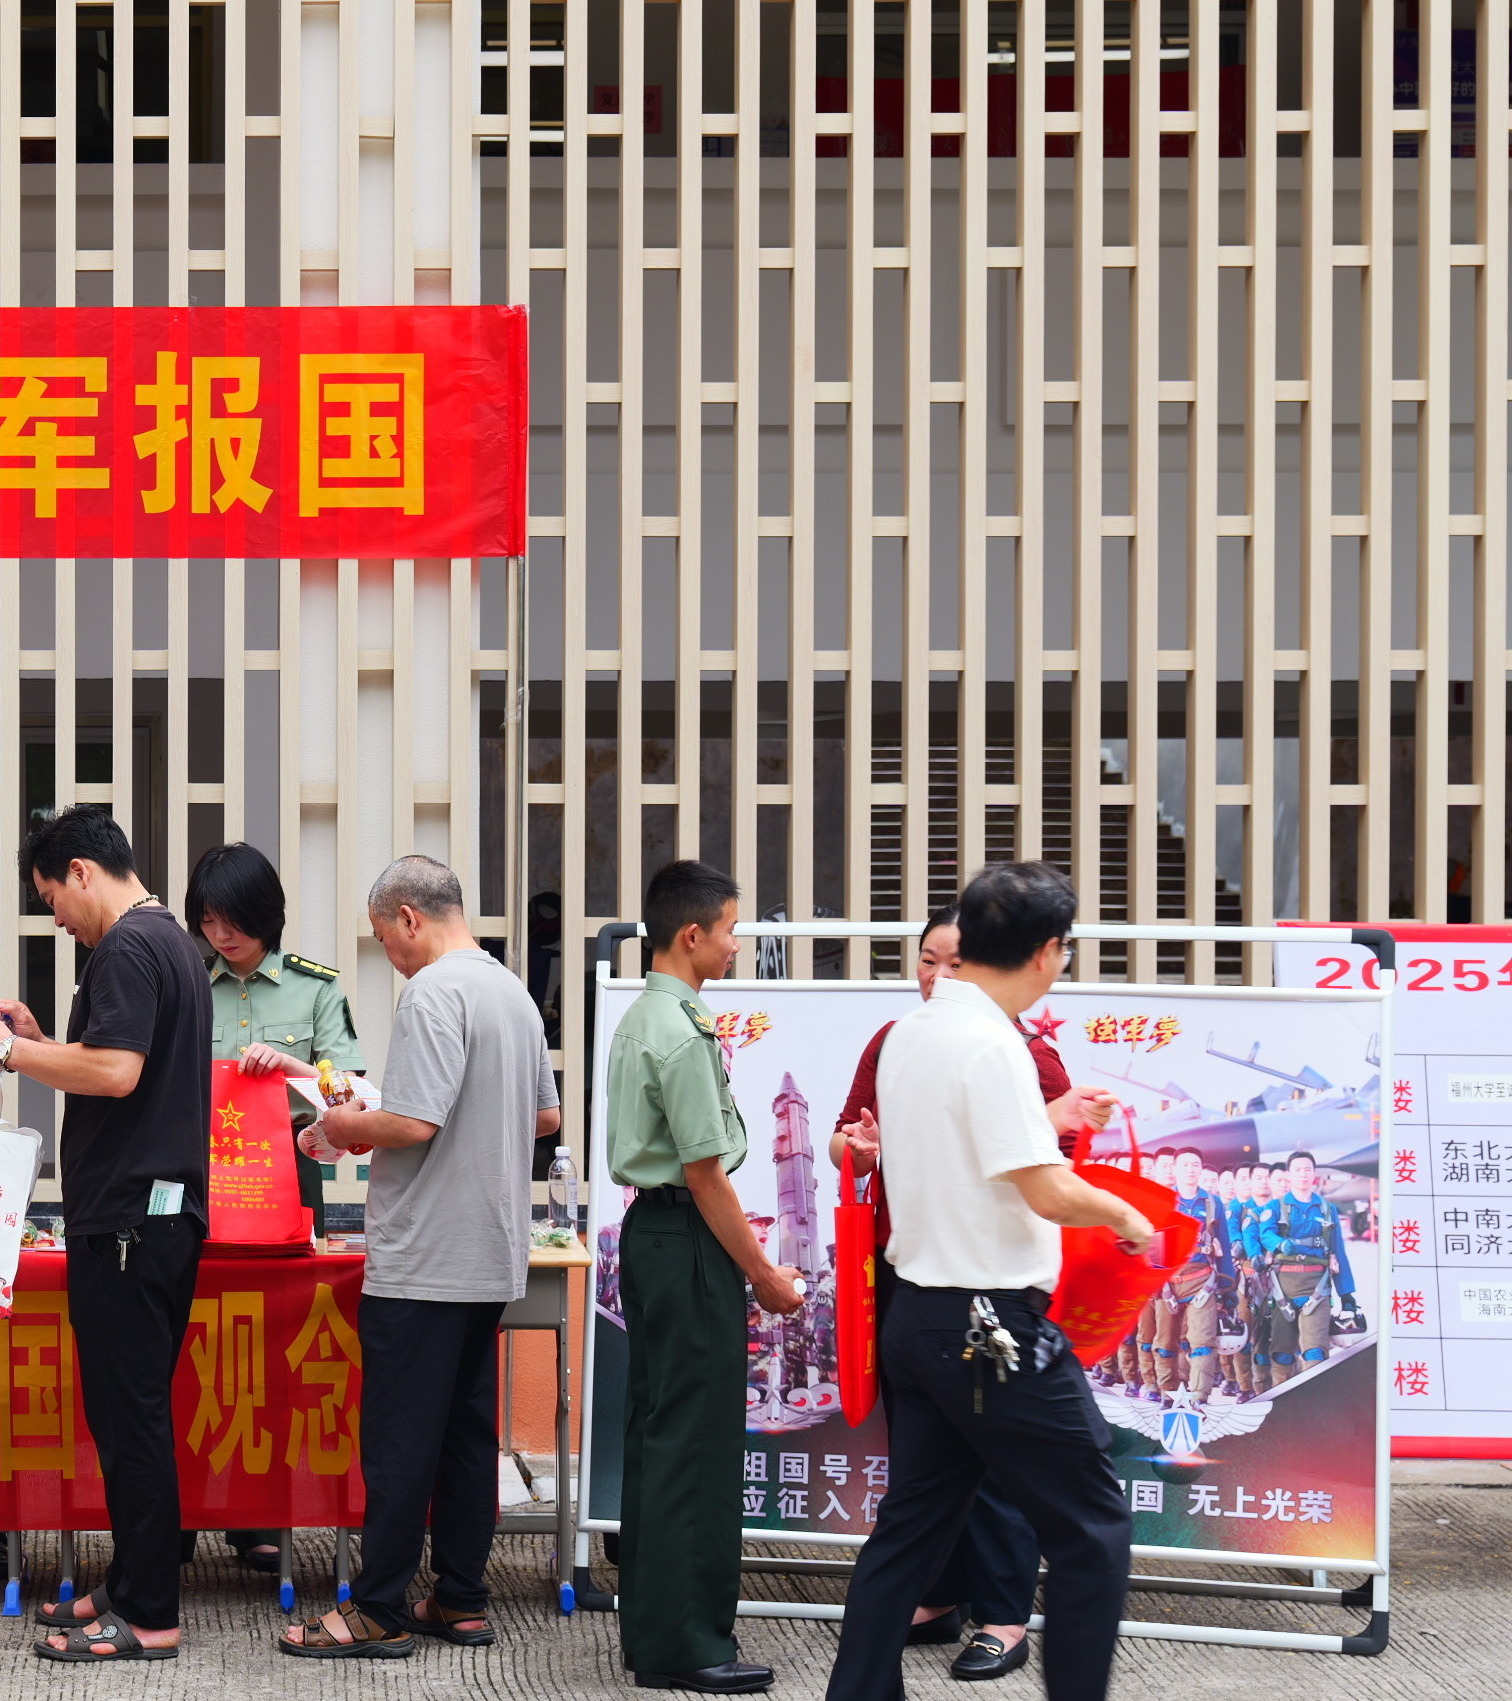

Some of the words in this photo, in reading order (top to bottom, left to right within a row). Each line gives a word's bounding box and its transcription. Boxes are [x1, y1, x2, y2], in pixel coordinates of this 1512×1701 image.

[210, 1134, 273, 1151] 春只有一次
[210, 1153, 274, 1169] 军荣耀一生
[1444, 1233, 1512, 1256] 同济
[1463, 1288, 1512, 1302] 中国农
[1391, 1289, 1426, 1325] 楼
[1478, 1303, 1512, 1317] 海南
[1393, 1360, 1430, 1397] 楼
[743, 1449, 890, 1488] 祖国号召
[1117, 1478, 1165, 1515] 国
[1186, 1483, 1334, 1526] 无上光荣
